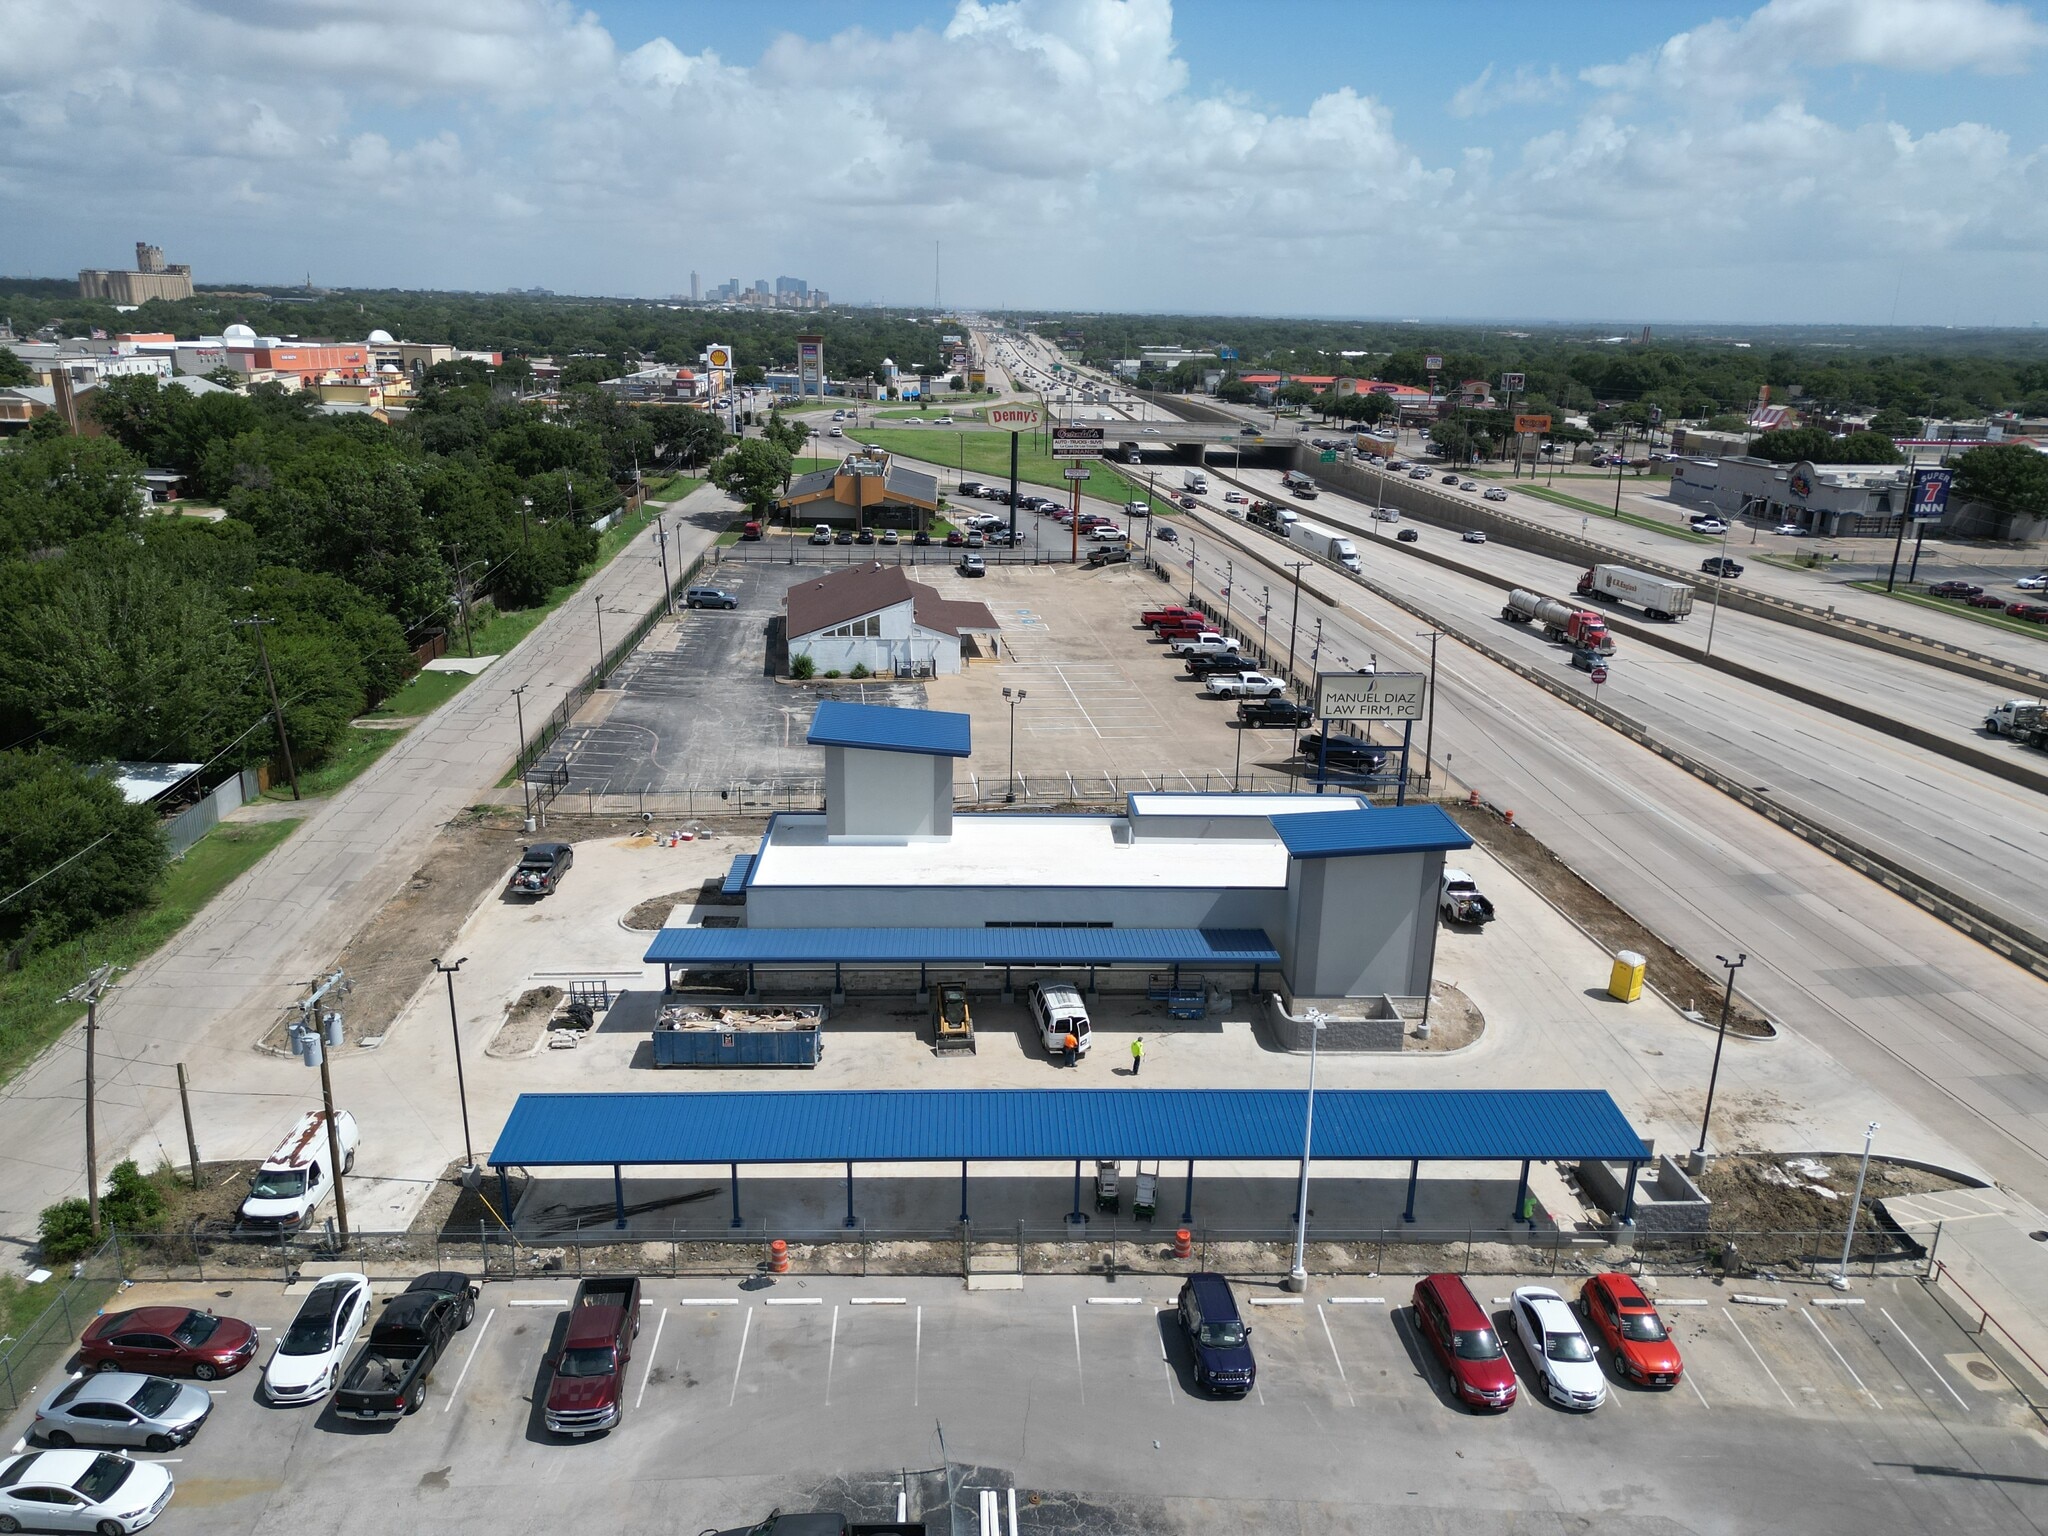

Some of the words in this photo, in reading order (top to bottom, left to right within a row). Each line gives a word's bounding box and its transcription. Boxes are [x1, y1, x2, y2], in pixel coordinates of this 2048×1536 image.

[992, 409, 1038, 423] Denny's
[1921, 472, 1950, 483] SUPER
[1924, 482, 1942, 502] 7
[1914, 503, 1944, 512] INN
[1326, 693, 1381, 703] MANUEL
[1384, 693, 1416, 703] DIAZ
[1325, 705, 1356, 715] LAW
[1360, 705, 1393, 716] FIRM,
[1397, 705, 1415, 715] PC
